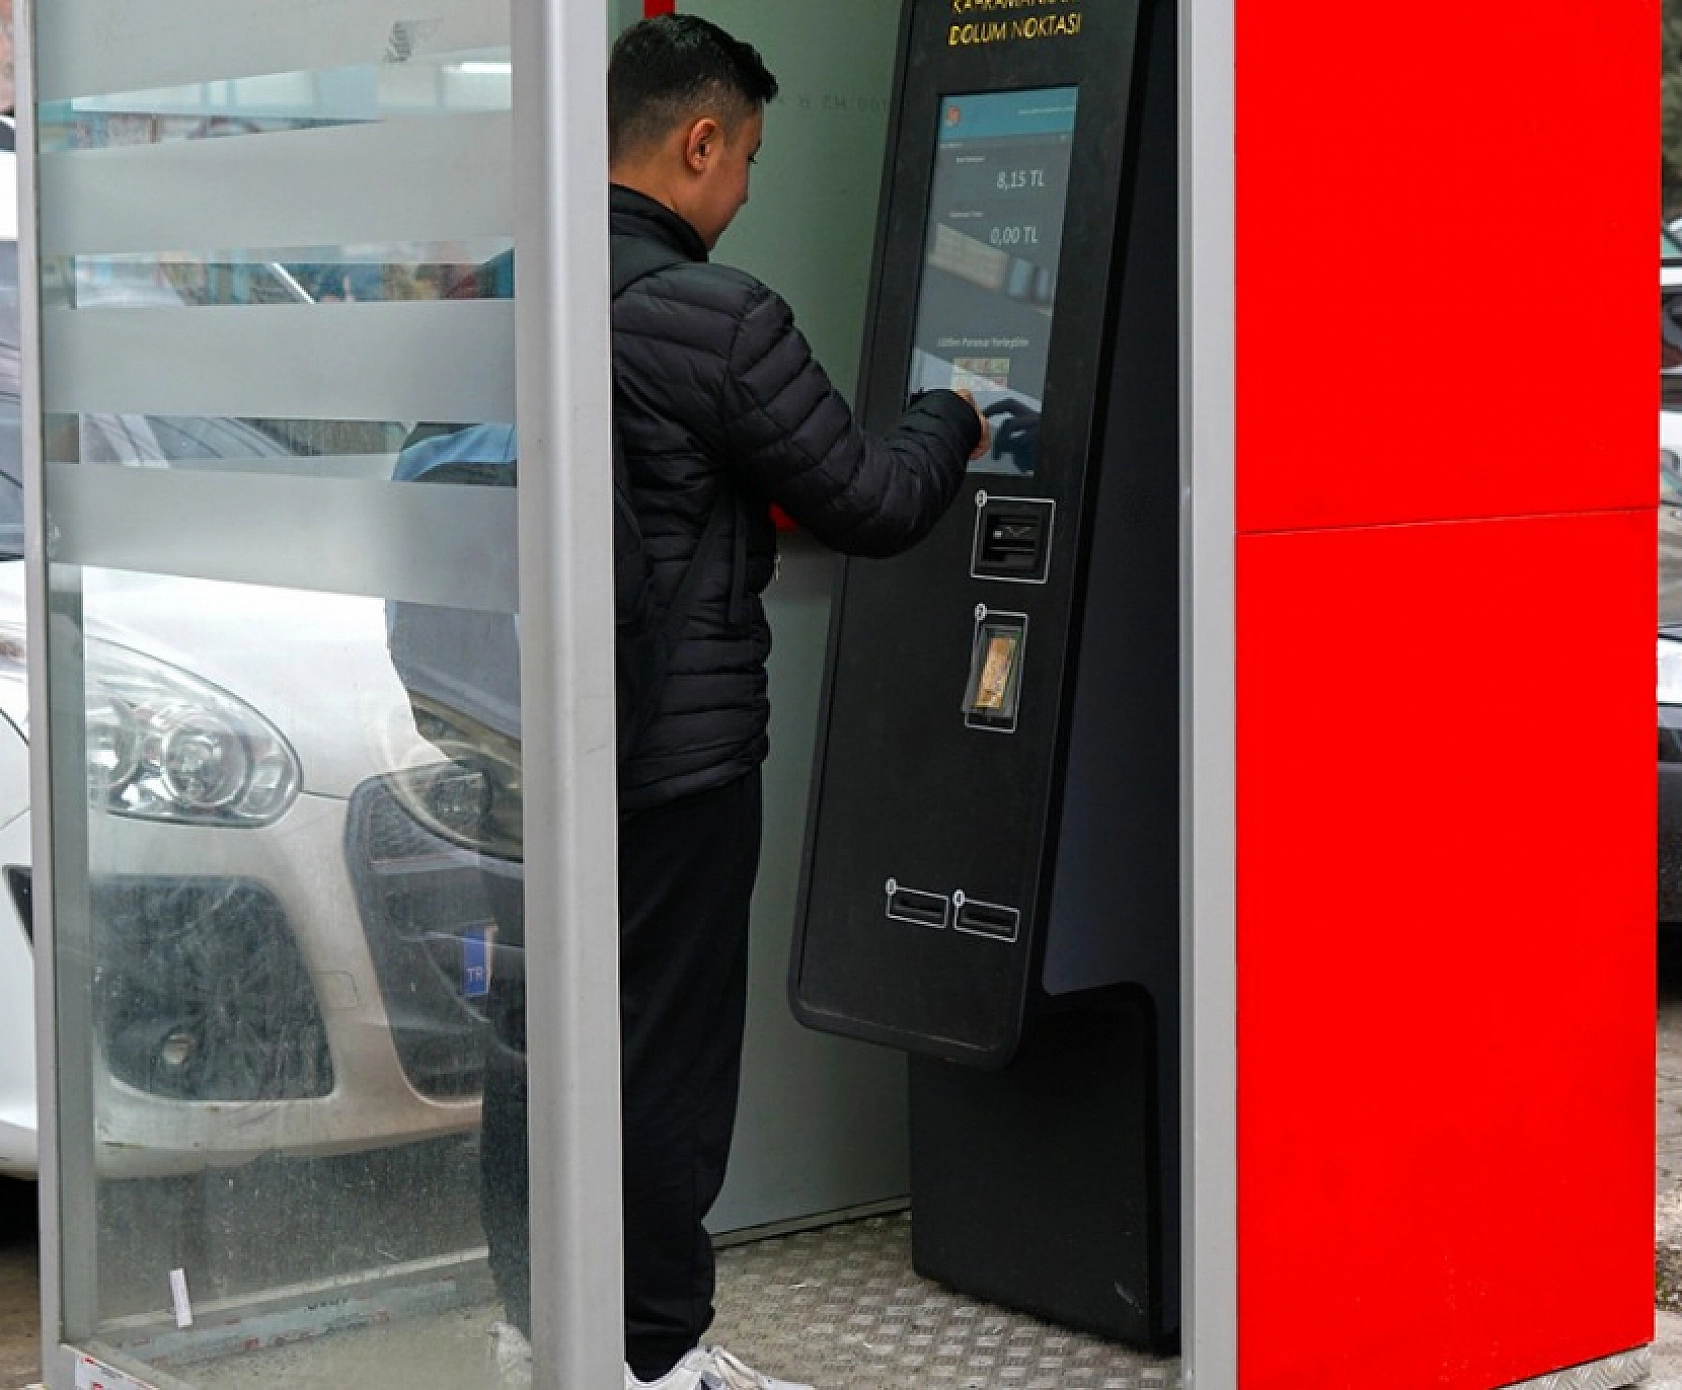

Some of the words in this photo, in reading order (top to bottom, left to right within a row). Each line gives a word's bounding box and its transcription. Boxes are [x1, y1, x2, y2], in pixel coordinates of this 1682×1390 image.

[949, 23, 1006, 45] DOLUM
[1012, 13, 1081, 38] NOKTASI
[996, 170, 1026, 191] 8,15
[1029, 169, 1045, 187] TL
[990, 226, 1020, 246] 0,00
[1023, 225, 1039, 244] TL
[466, 966, 483, 982] TR
